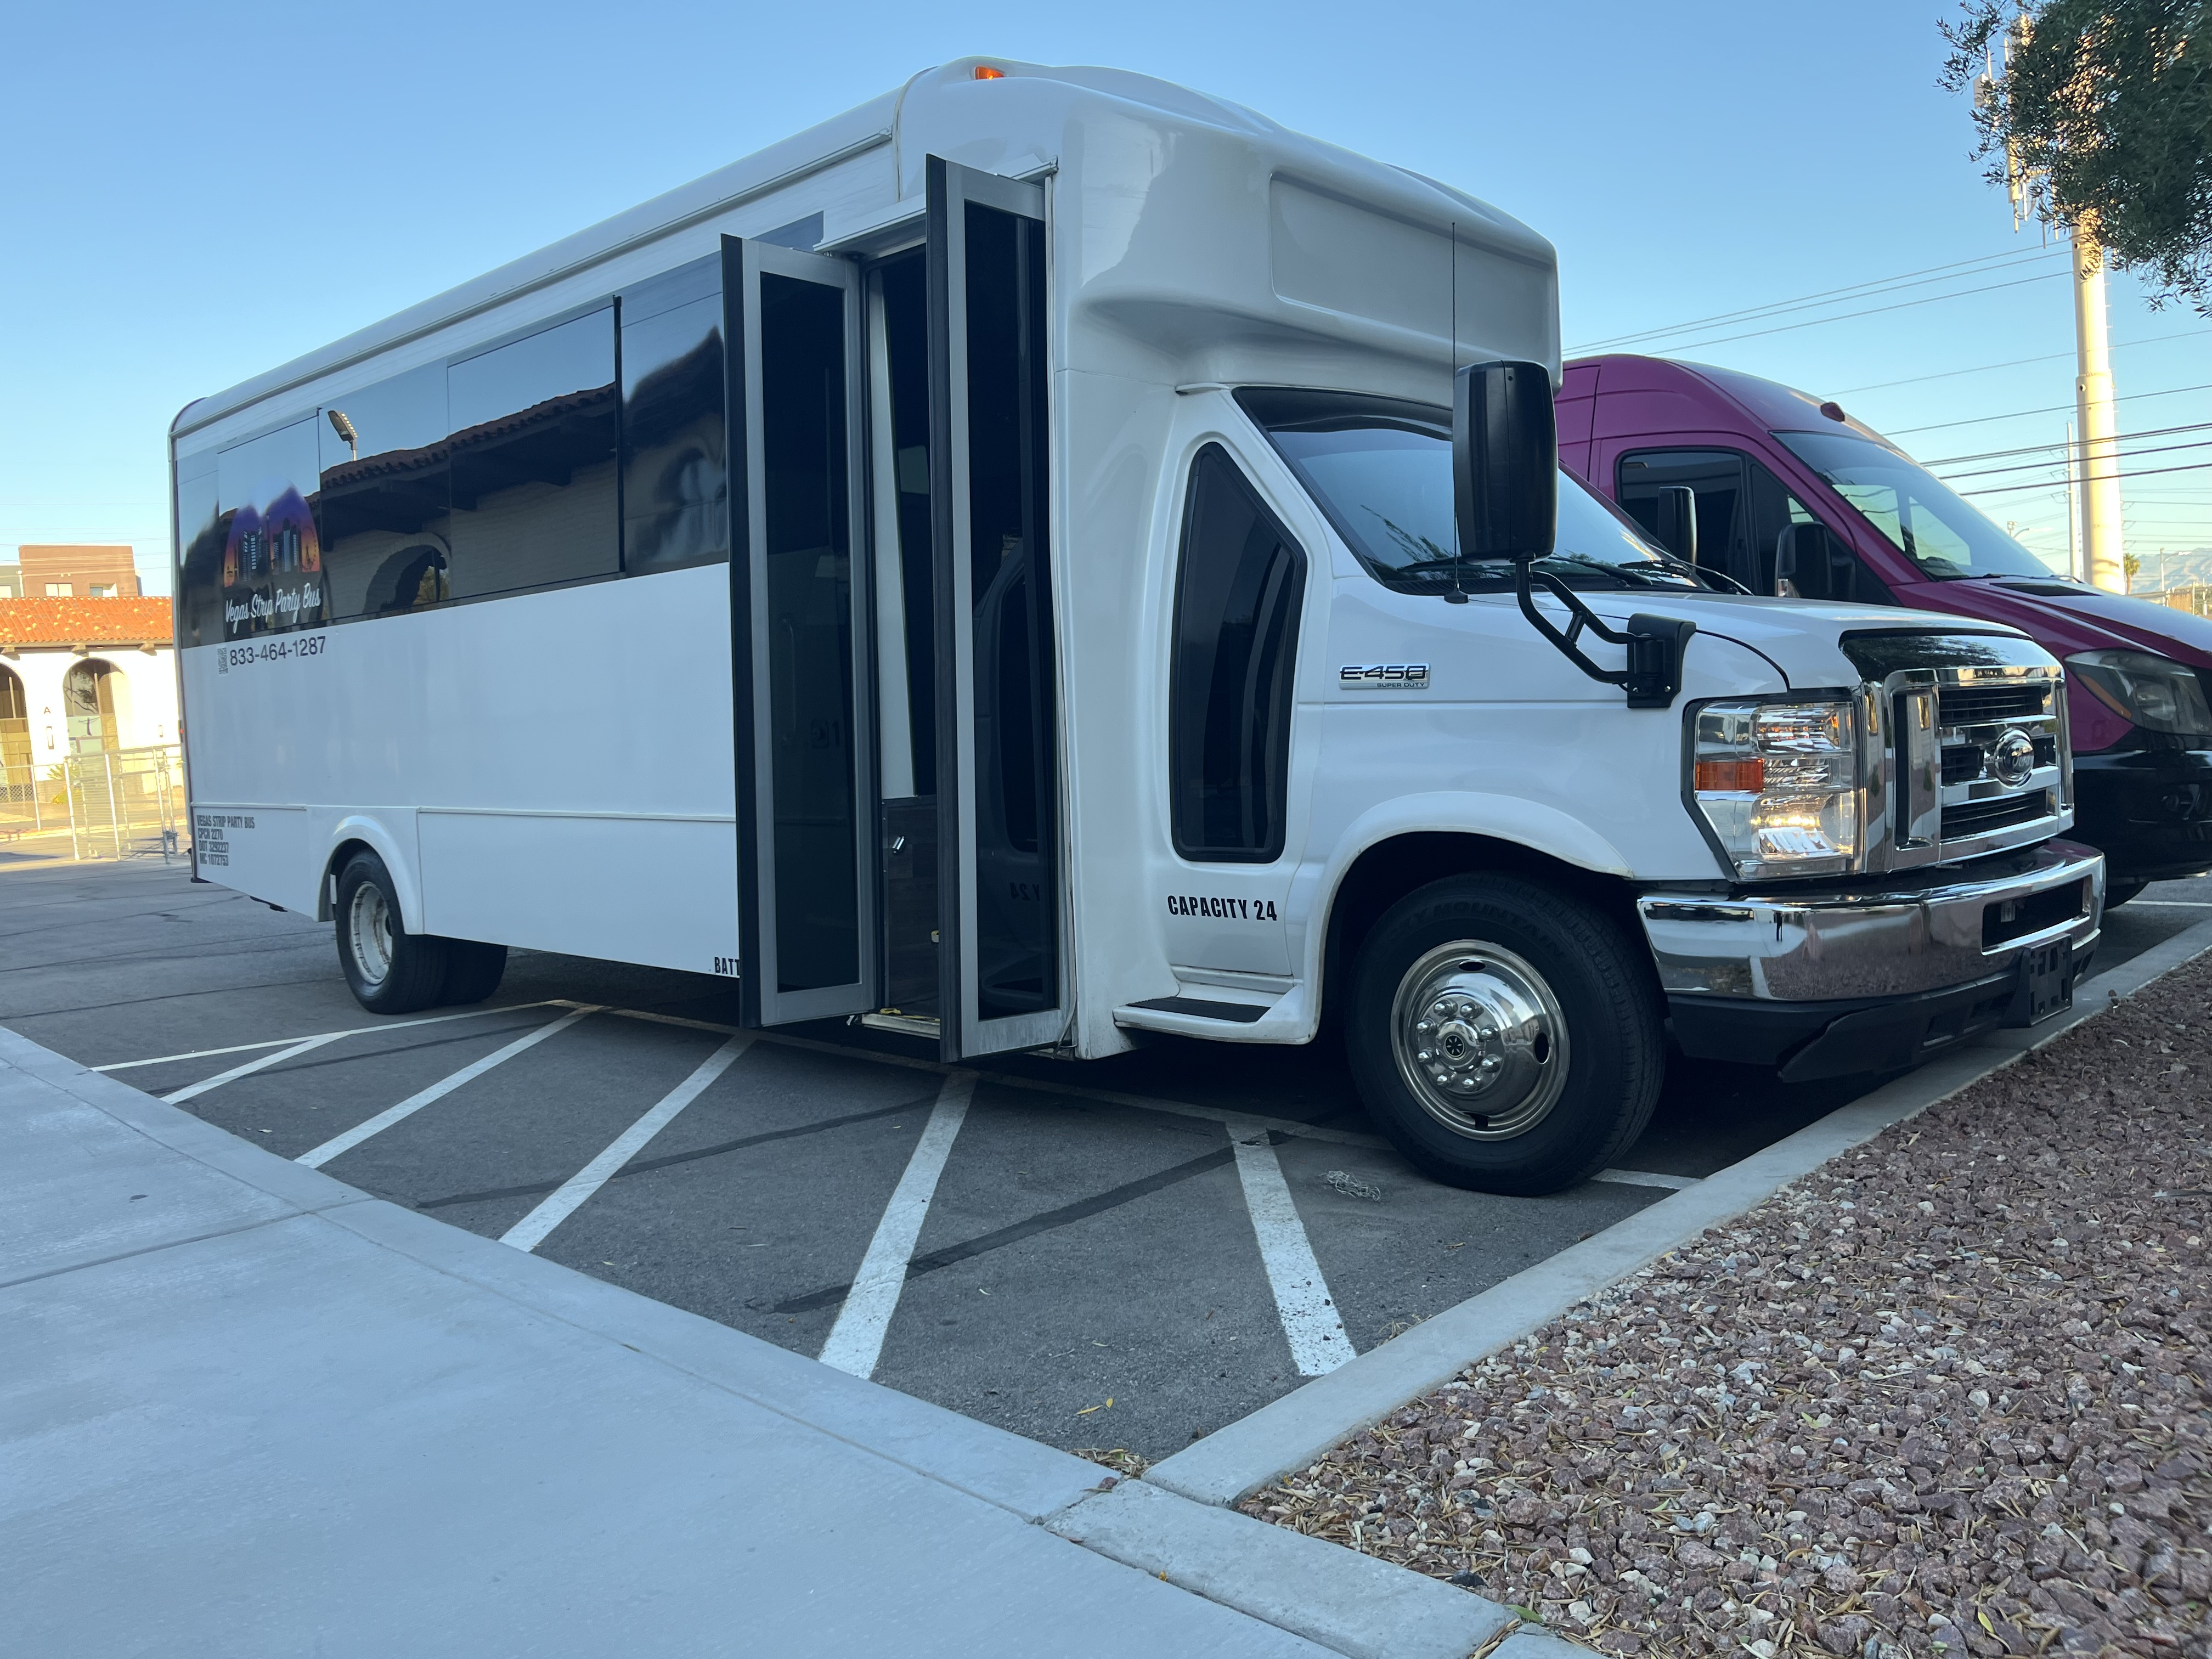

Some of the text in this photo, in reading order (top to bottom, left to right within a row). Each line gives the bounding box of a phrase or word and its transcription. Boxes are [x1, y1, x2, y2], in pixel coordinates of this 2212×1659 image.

[225, 582, 321, 634] Vegas Strip Party Bus
[230, 636, 326, 665] 833-464-1287
[196, 815, 255, 829] VEGAS STRIP PARTY BUS
[211, 828, 223, 840] 2270
[199, 840, 207, 851] DOT
[199, 853, 207, 865] MC
[1167, 895, 1277, 921] CAPACITY 24
